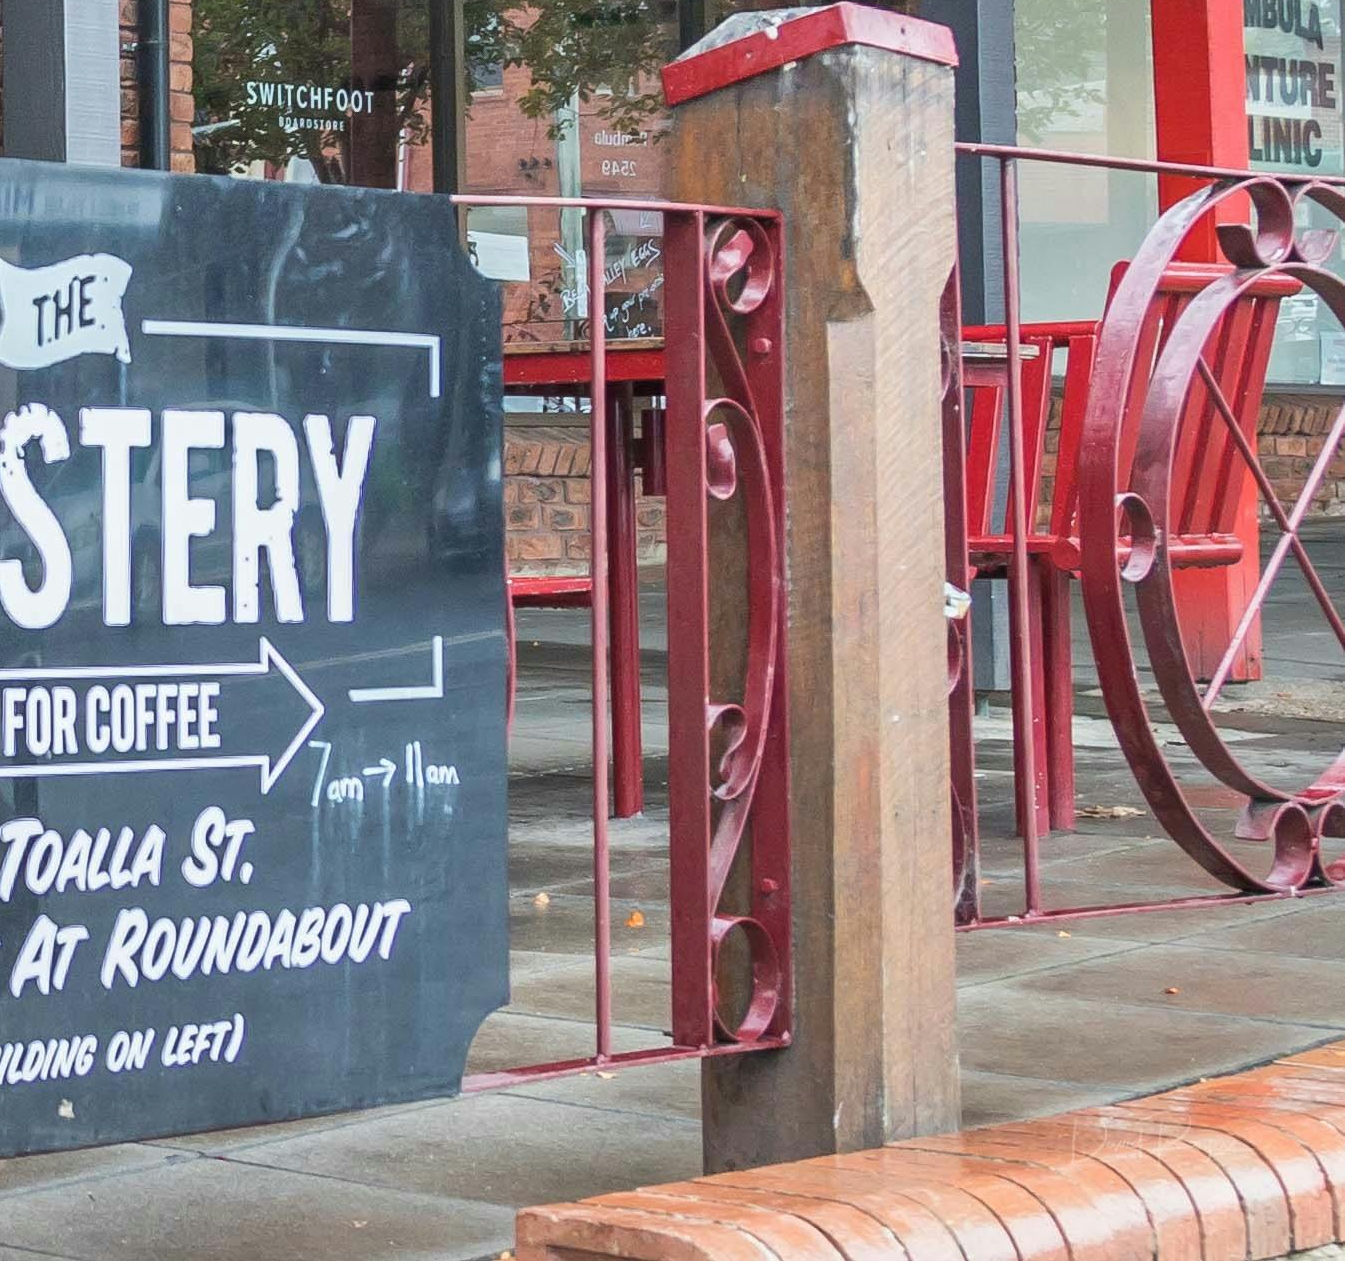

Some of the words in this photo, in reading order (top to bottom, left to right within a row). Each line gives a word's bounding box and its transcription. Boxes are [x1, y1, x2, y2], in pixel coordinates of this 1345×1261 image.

[246, 81, 375, 114] SWITCHFOOT
[1245, 54, 1337, 110] NTURE
[278, 116, 345, 132] BOARDSTORE
[1248, 116, 1323, 168] LINIC
[32, 274, 105, 349] THE
[1, 685, 80, 757] FOR
[84, 682, 223, 753] COFFEE
[307, 740, 365, 807] 7am
[405, 740, 461, 789] 11am
[183, 805, 255, 887] ST.
[8, 911, 86, 995] AT
[99, 897, 411, 989] ROUNDABOUT
[104, 1030, 155, 1076] ON
[159, 1012, 246, 1070] LEFT)
